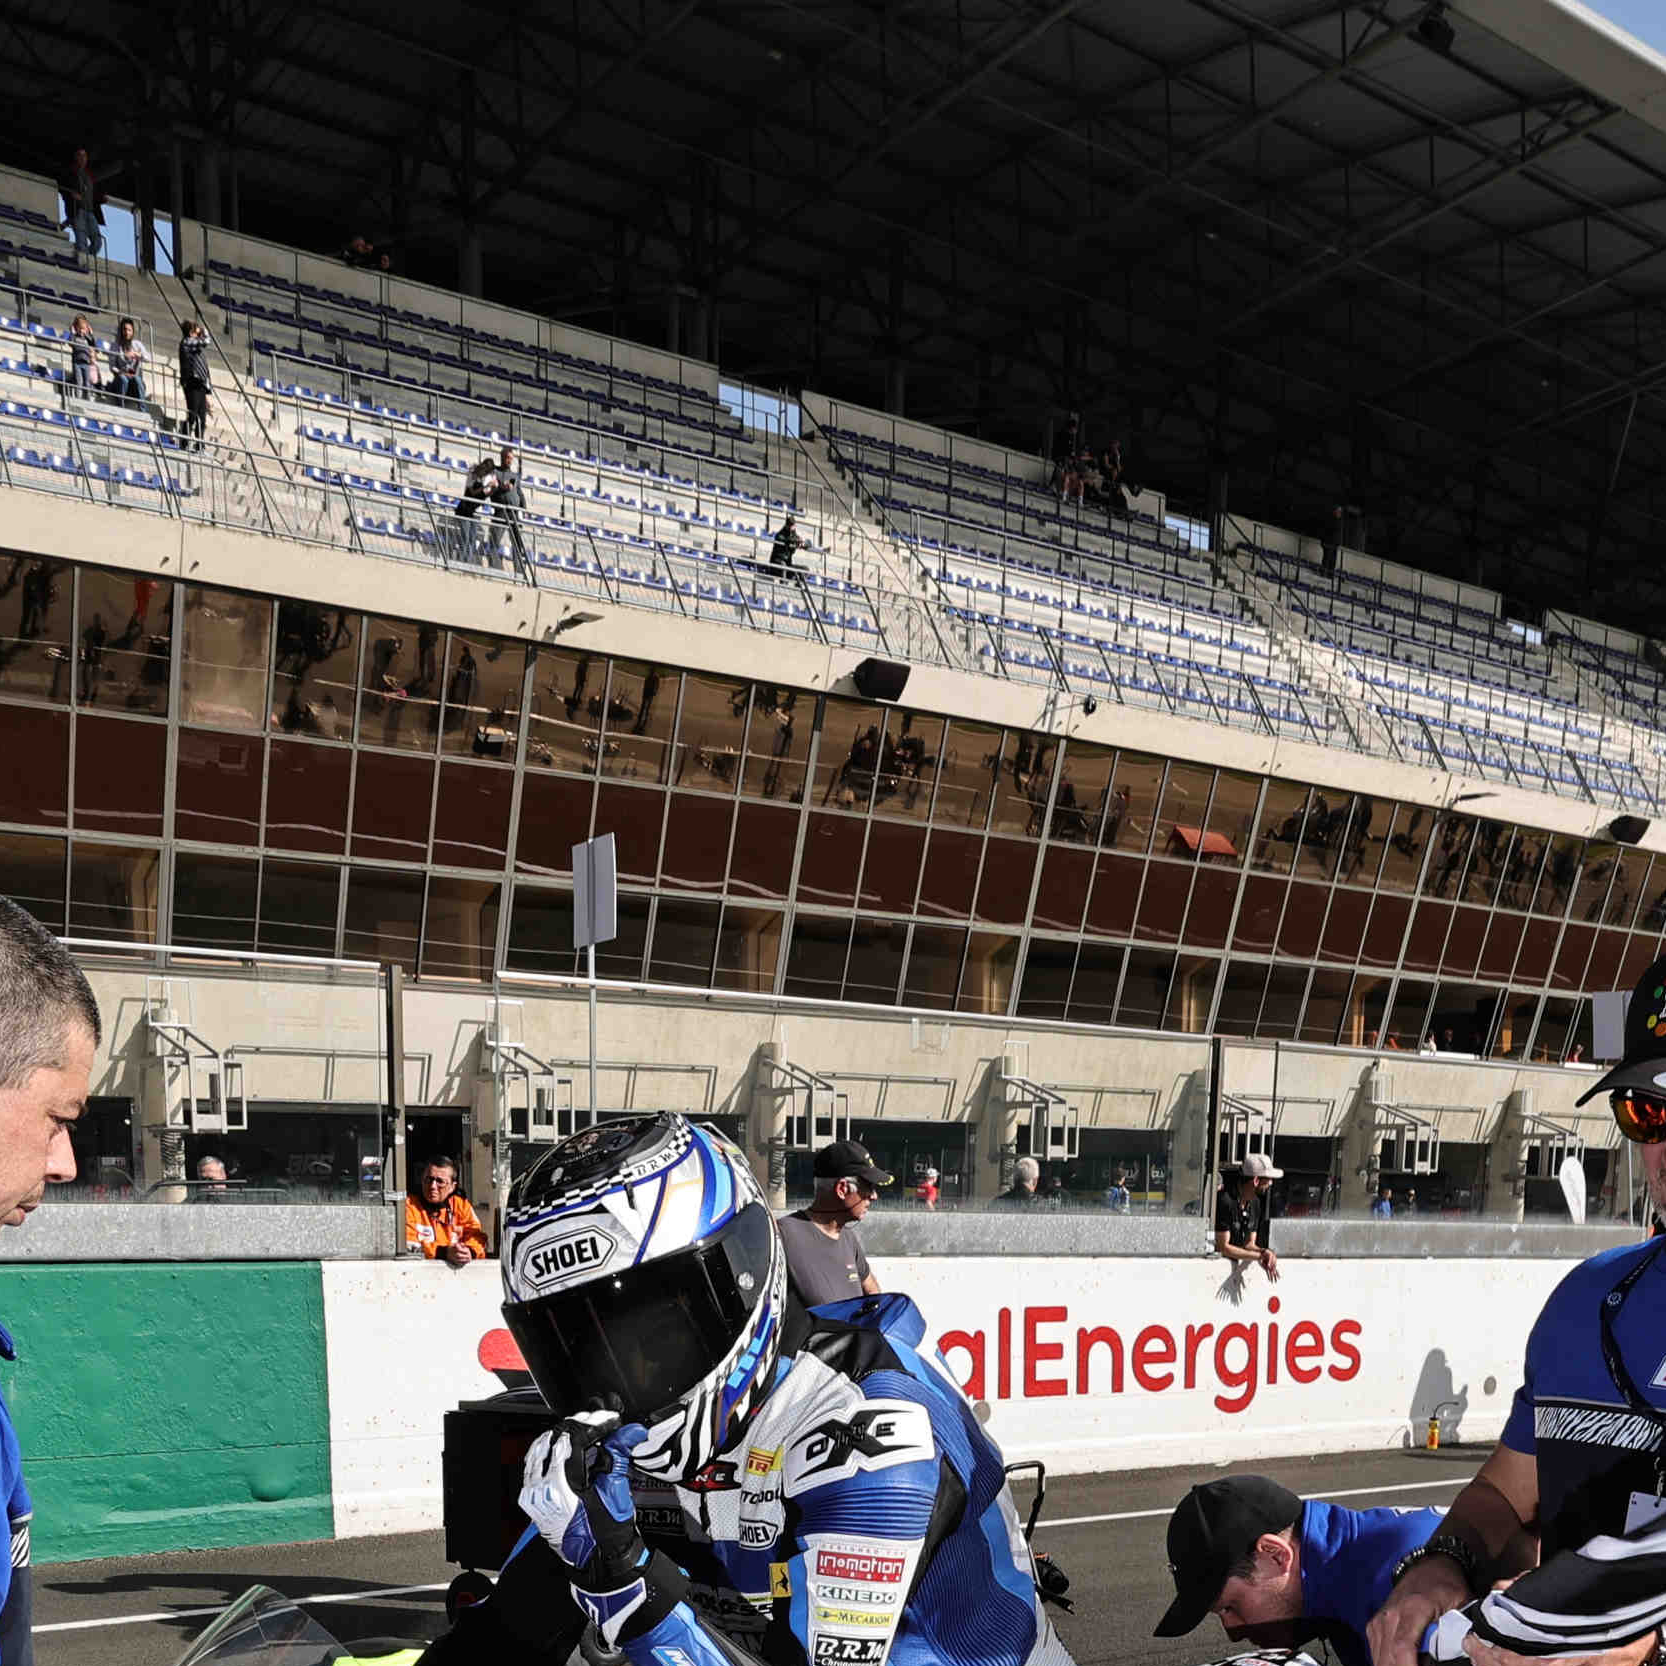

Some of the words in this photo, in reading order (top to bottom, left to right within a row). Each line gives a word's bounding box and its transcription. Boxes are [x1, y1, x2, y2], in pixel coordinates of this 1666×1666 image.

[531, 1236, 600, 1279] SHOEI
[936, 1295, 1362, 1414] alEnergies
[817, 1585, 896, 1605] KINEDO
